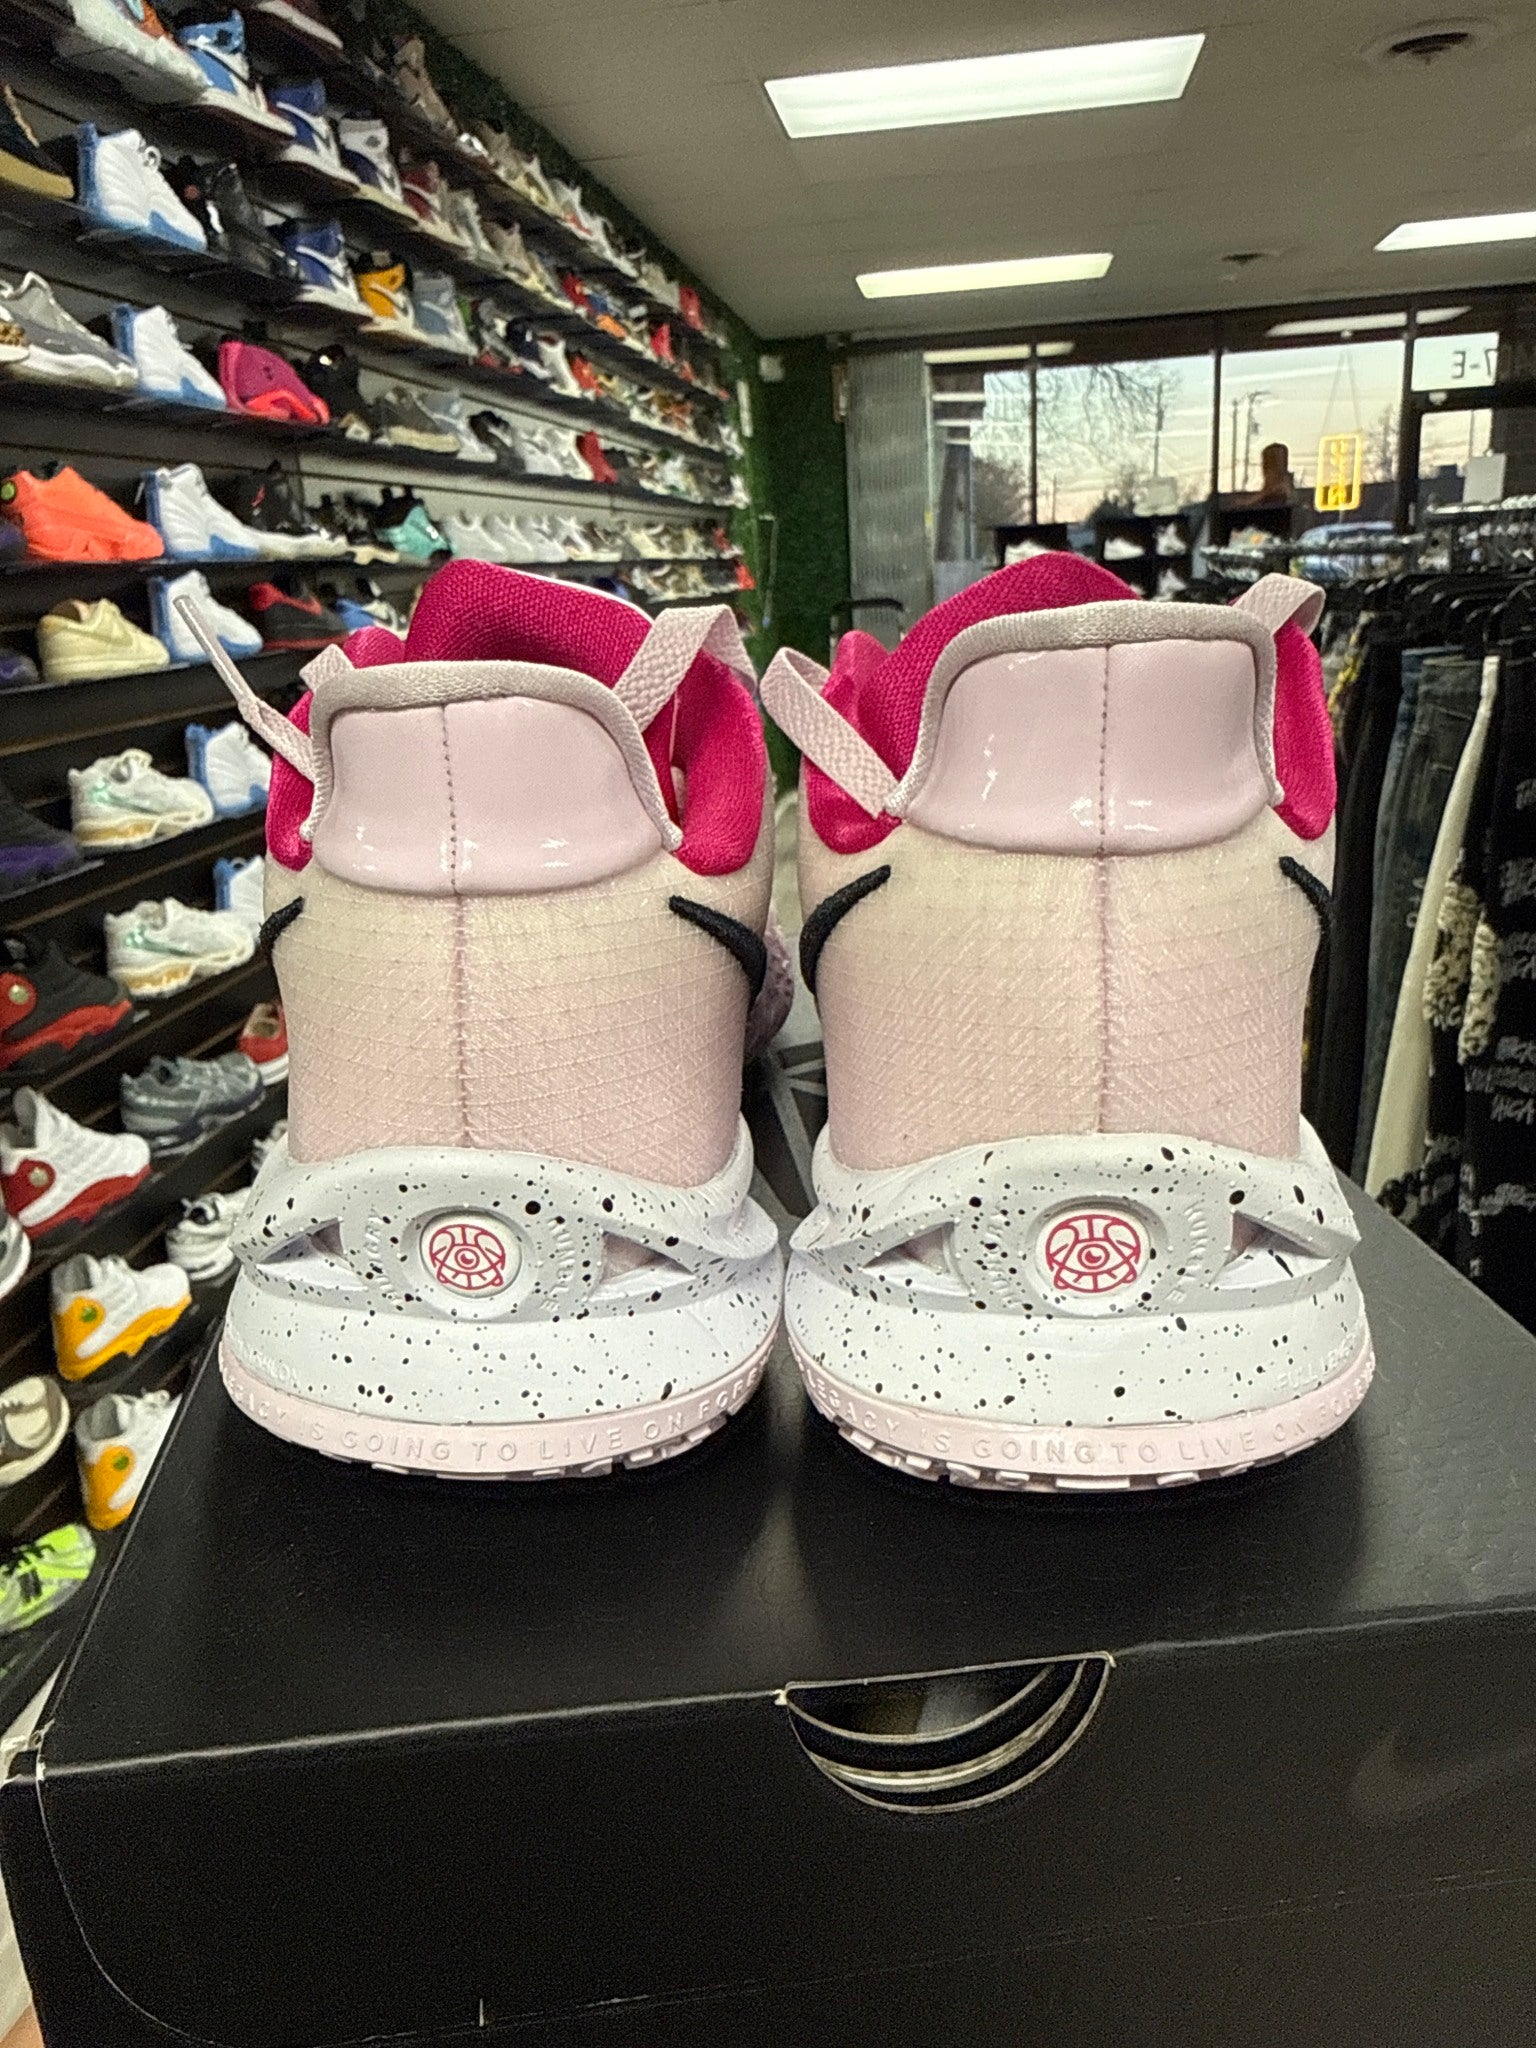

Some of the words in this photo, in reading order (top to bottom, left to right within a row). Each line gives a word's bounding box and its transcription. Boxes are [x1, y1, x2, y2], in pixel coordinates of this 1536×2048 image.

[341, 1430, 451, 1460] GOING
[471, 1440, 517, 1462] TO
[539, 1427, 624, 1460] LIVE
[643, 1411, 683, 1440] ON
[919, 1427, 952, 1453] IS
[973, 1438, 1096, 1464] GOING
[1110, 1442, 1159, 1463] TO
[1178, 1430, 1256, 1461] LIVE
